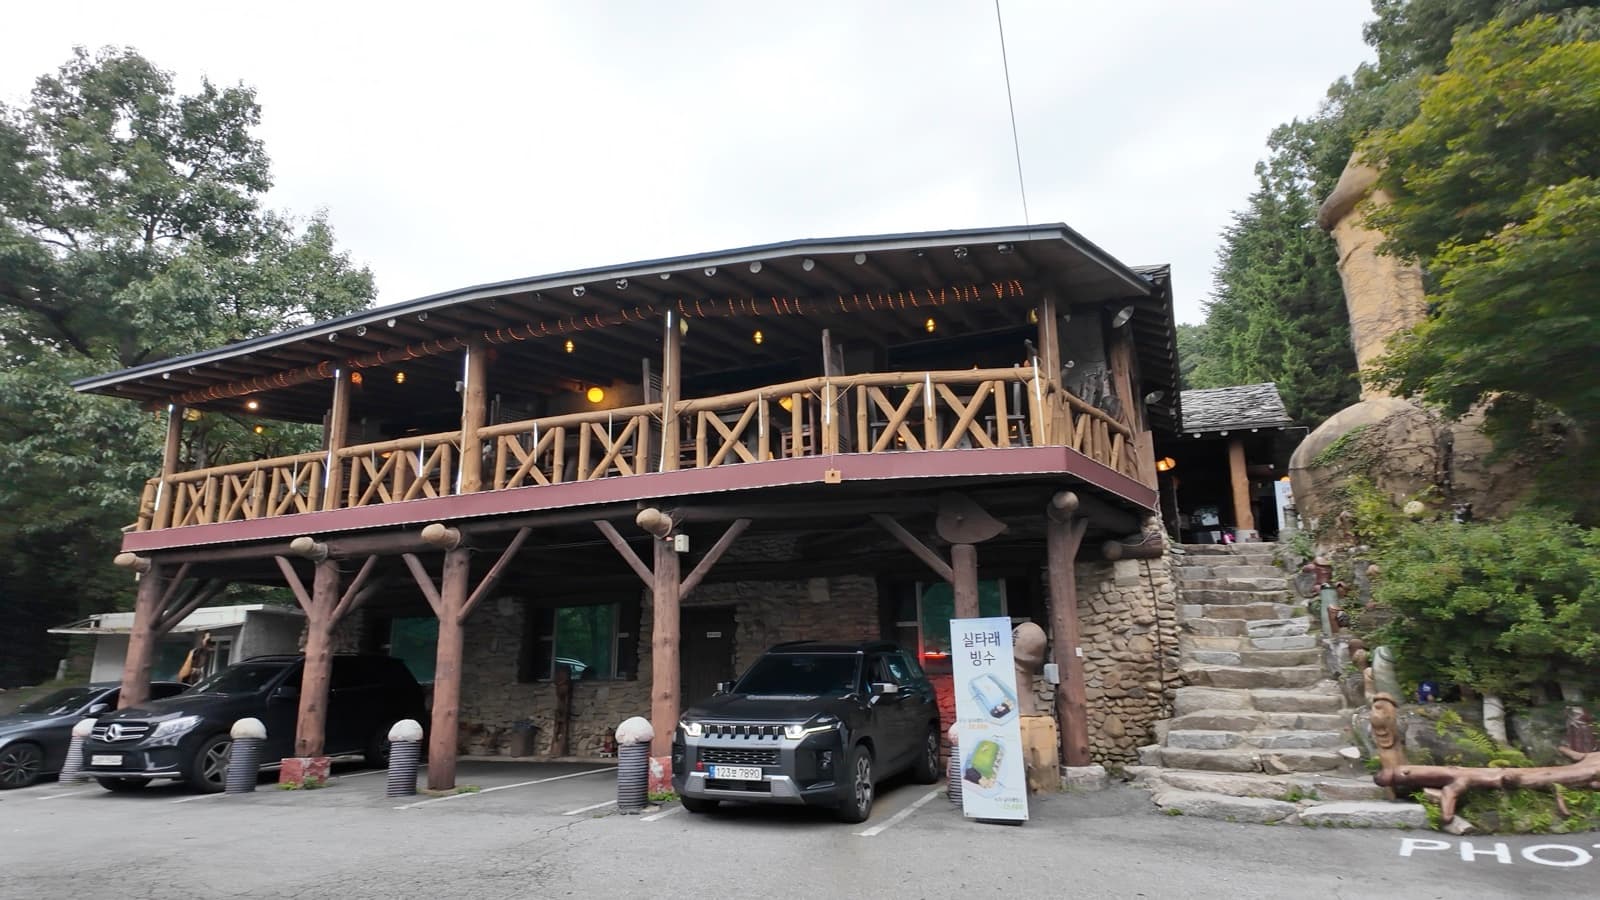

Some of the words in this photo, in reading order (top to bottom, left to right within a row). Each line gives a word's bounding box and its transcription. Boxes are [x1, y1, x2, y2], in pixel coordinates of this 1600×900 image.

[962, 631, 1001, 648] 실타래
[970, 650, 996, 667] 빙수
[1398, 837, 1600, 867] PHO
